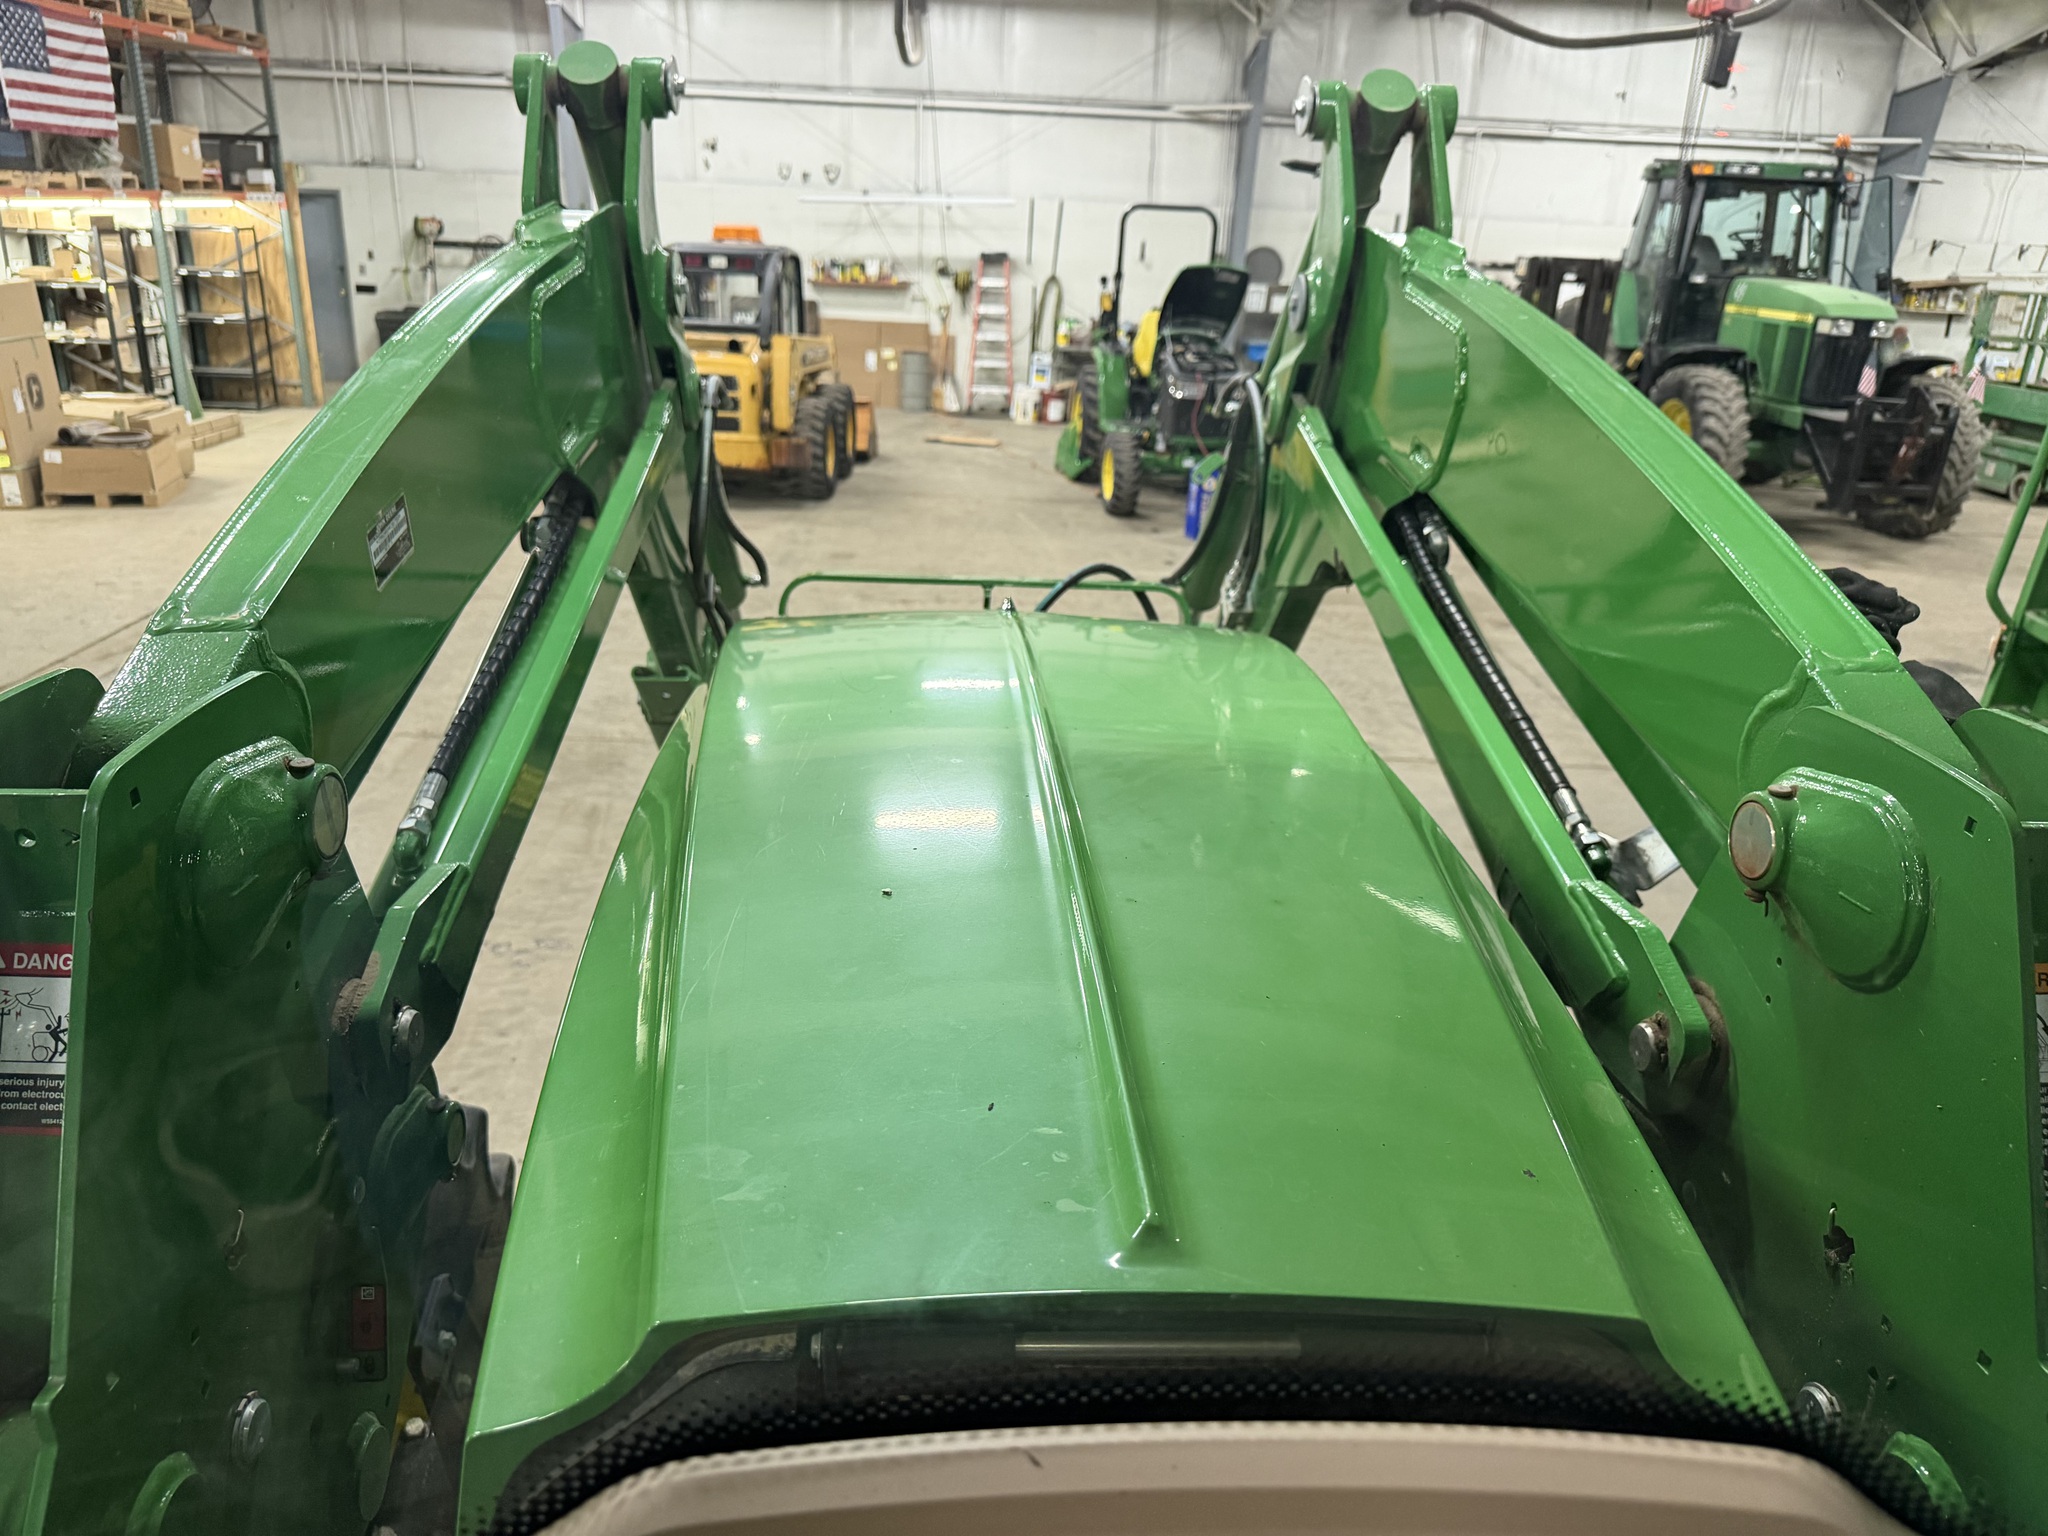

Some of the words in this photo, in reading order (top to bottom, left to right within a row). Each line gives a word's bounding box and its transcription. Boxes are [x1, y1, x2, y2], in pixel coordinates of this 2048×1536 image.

[13, 952, 73, 970] DANG
[0, 1077, 35, 1086] serious
[37, 1077, 65, 1089] injury
[0, 1090, 19, 1098] rom
[1, 1102, 37, 1110] contact
[40, 1102, 63, 1111] elect
